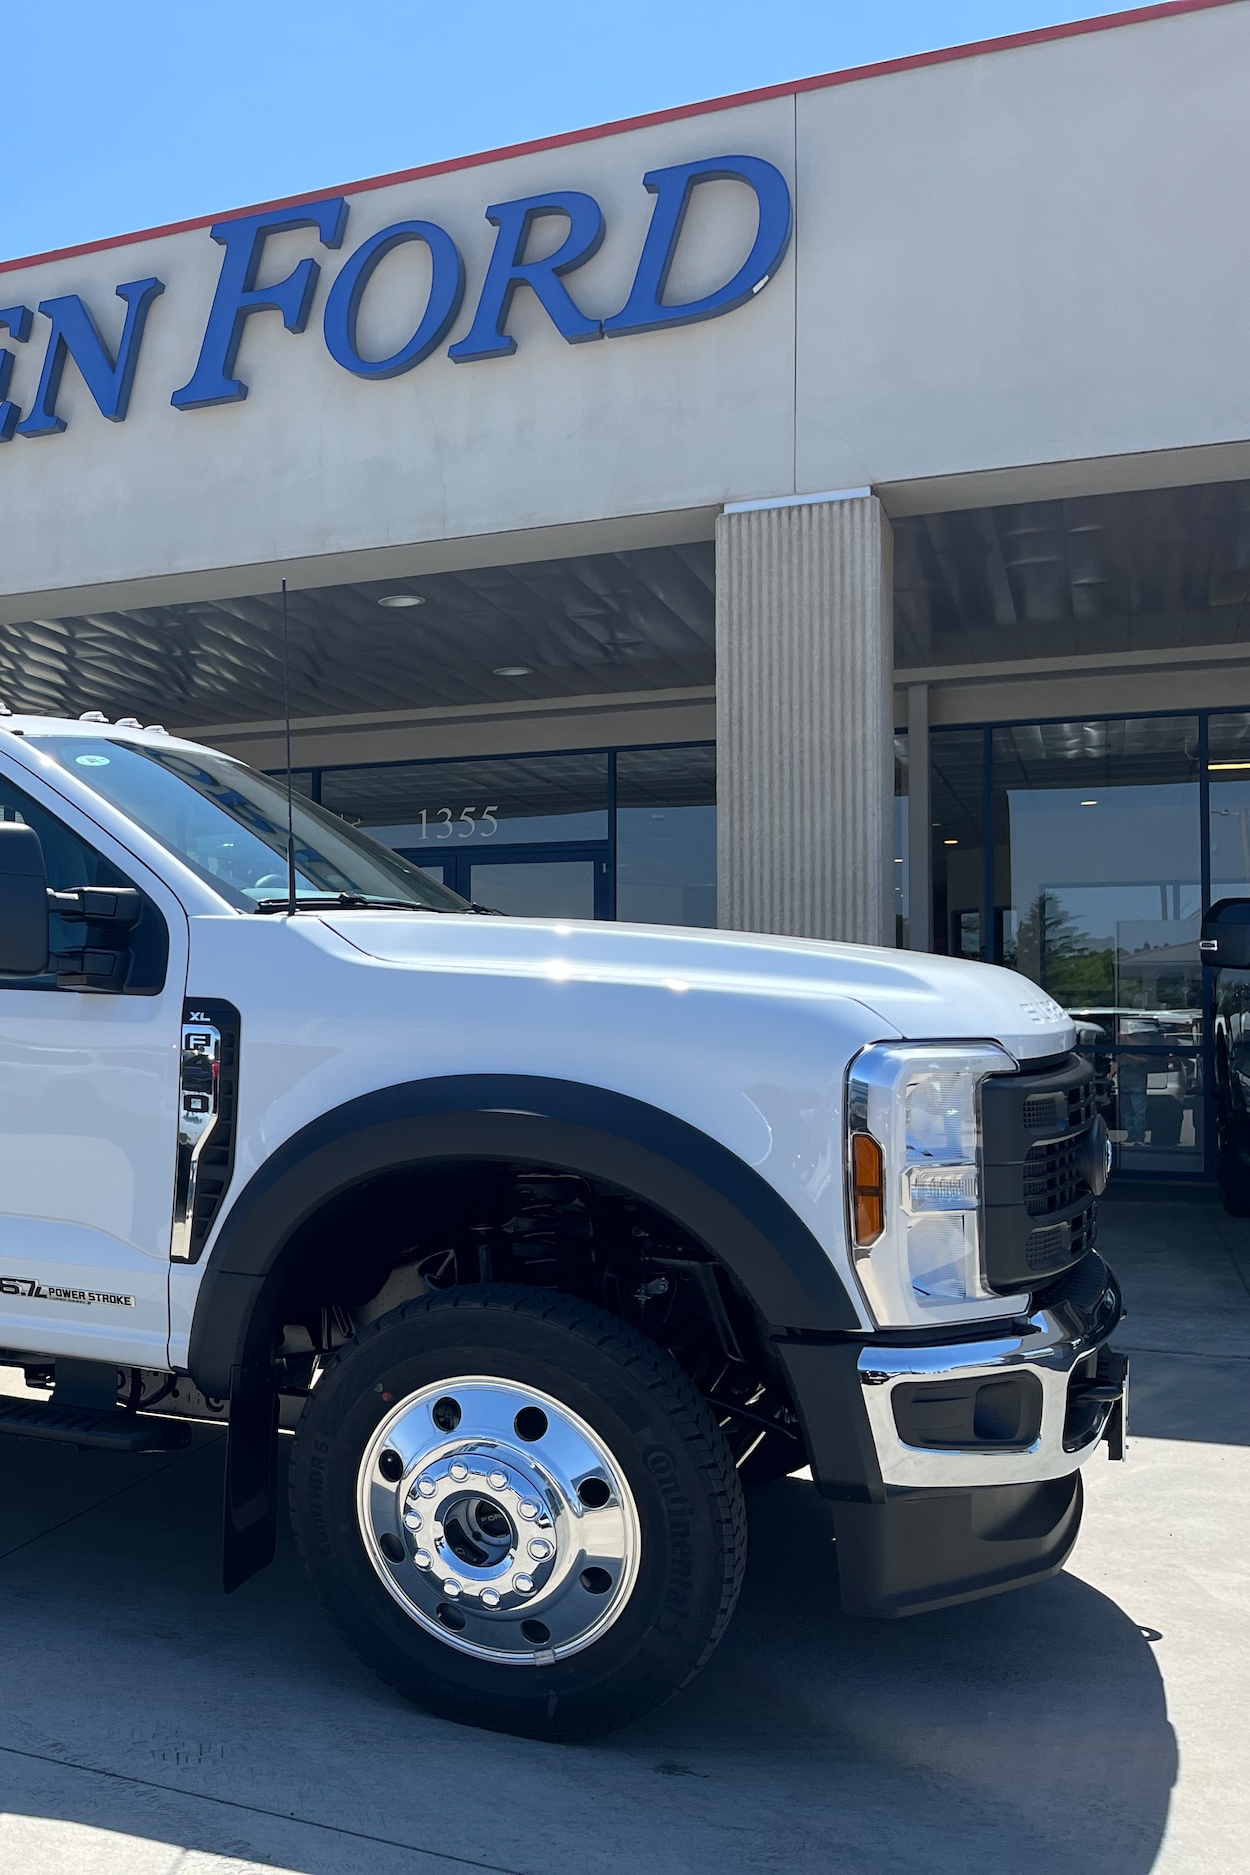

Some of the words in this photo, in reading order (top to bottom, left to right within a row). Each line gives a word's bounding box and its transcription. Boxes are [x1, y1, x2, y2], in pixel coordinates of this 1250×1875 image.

[170, 155, 793, 411] FORD
[417, 805, 499, 840] 1355
[189, 1011, 211, 1022] XL
[48, 1287, 86, 1301] POWER
[88, 1292, 132, 1306] STROKE
